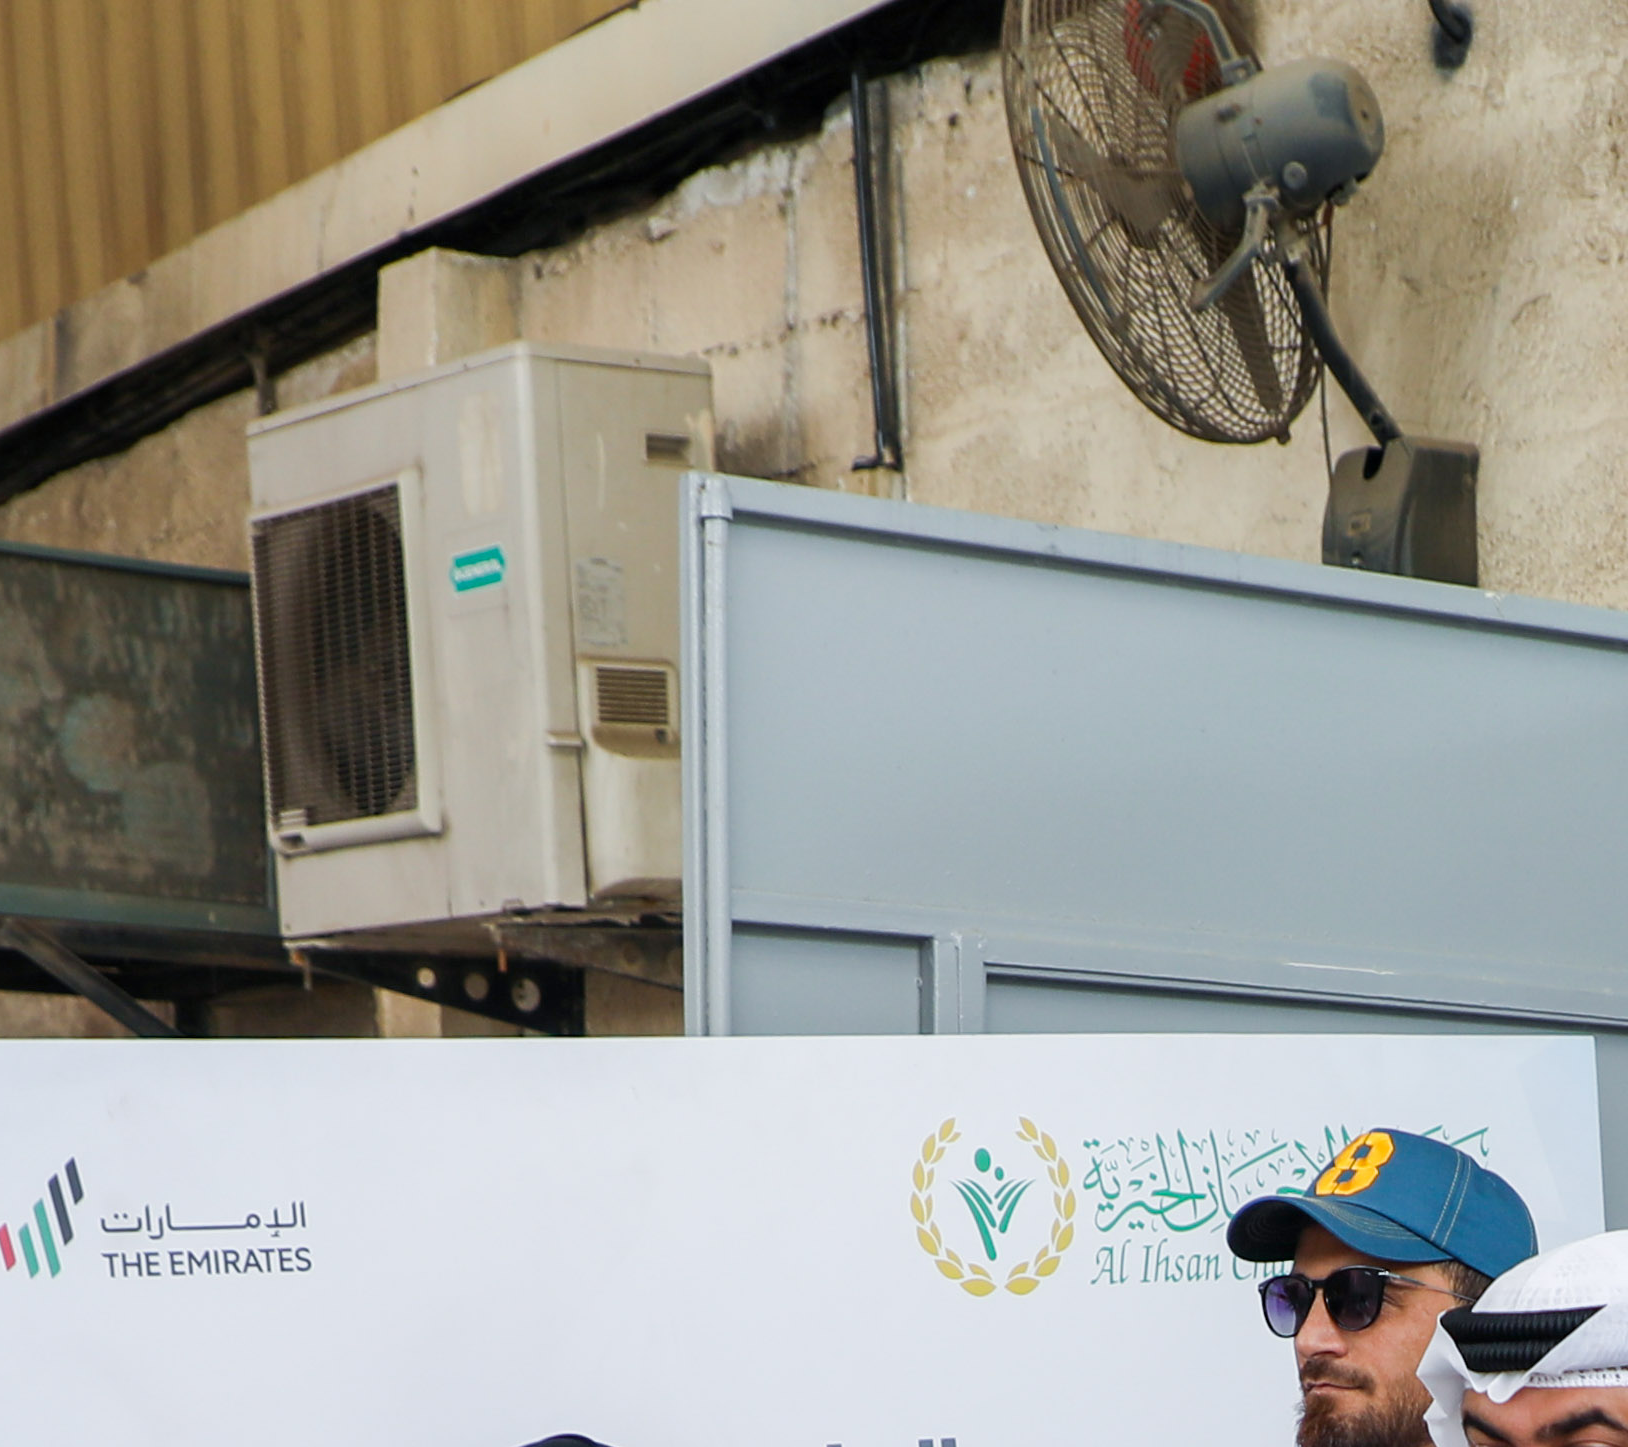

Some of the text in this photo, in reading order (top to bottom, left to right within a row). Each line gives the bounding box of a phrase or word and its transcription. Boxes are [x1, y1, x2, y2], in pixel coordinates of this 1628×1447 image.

[1315, 1132, 1396, 1197] 8
[101, 1248, 312, 1277] THE EMIRATES
[1090, 1238, 1221, 1285] Al Ihsan
